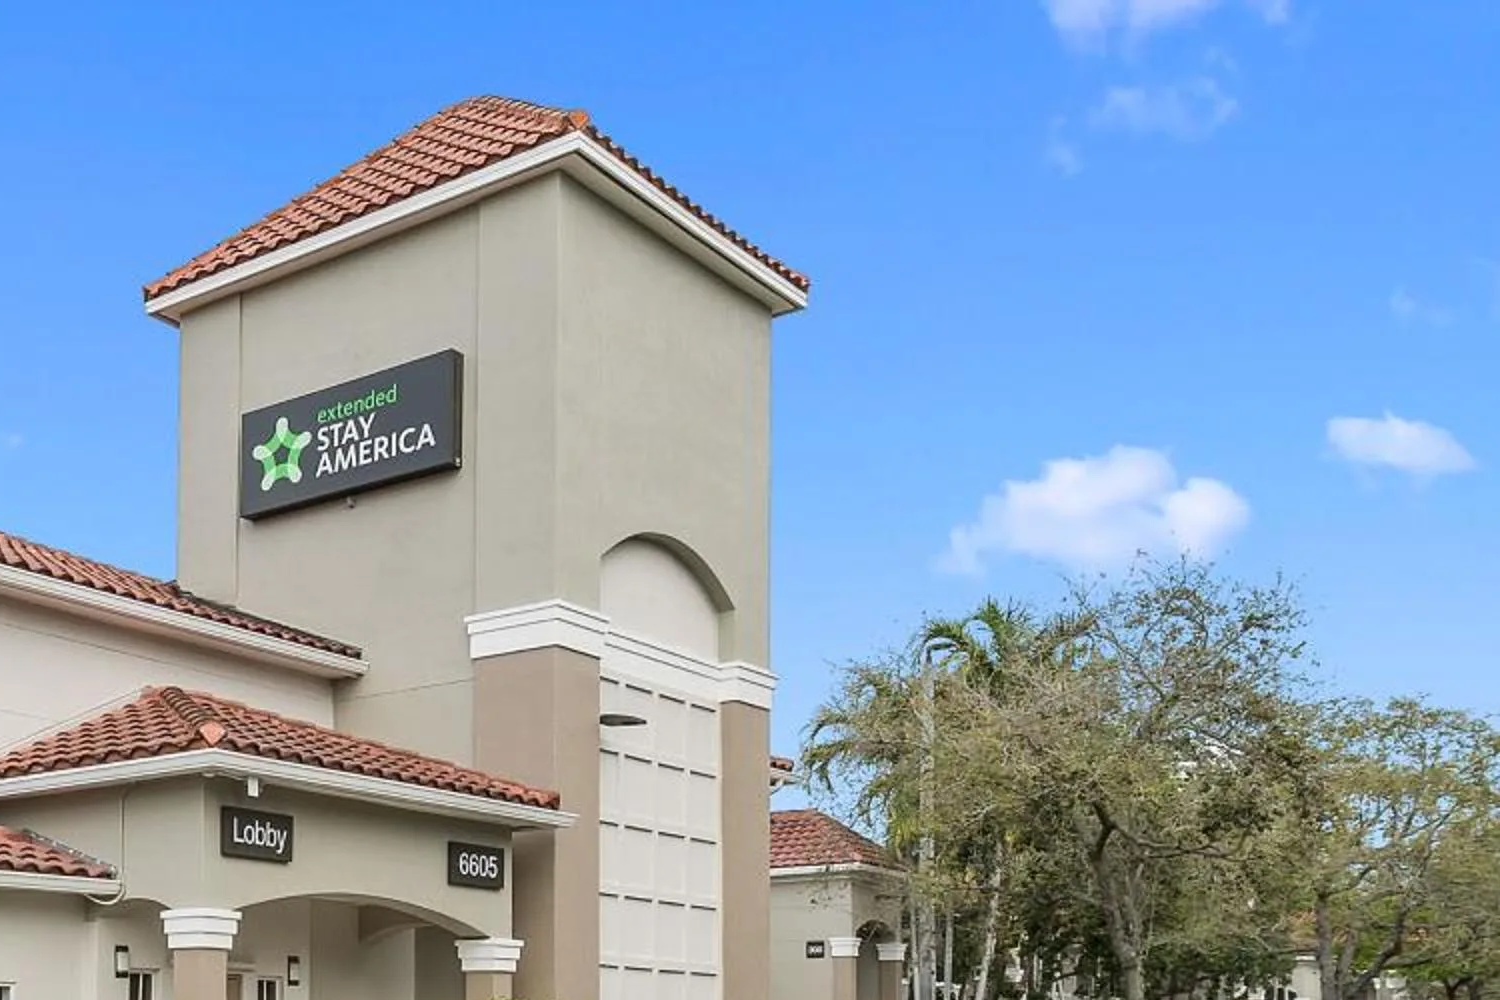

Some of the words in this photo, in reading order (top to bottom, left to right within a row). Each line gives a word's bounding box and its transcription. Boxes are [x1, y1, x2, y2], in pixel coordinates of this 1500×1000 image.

[317, 383, 397, 423] extended
[315, 423, 436, 478] AMERICA
[316, 411, 376, 451] STAY
[233, 815, 287, 854] Lobby
[459, 851, 499, 879] 6605
